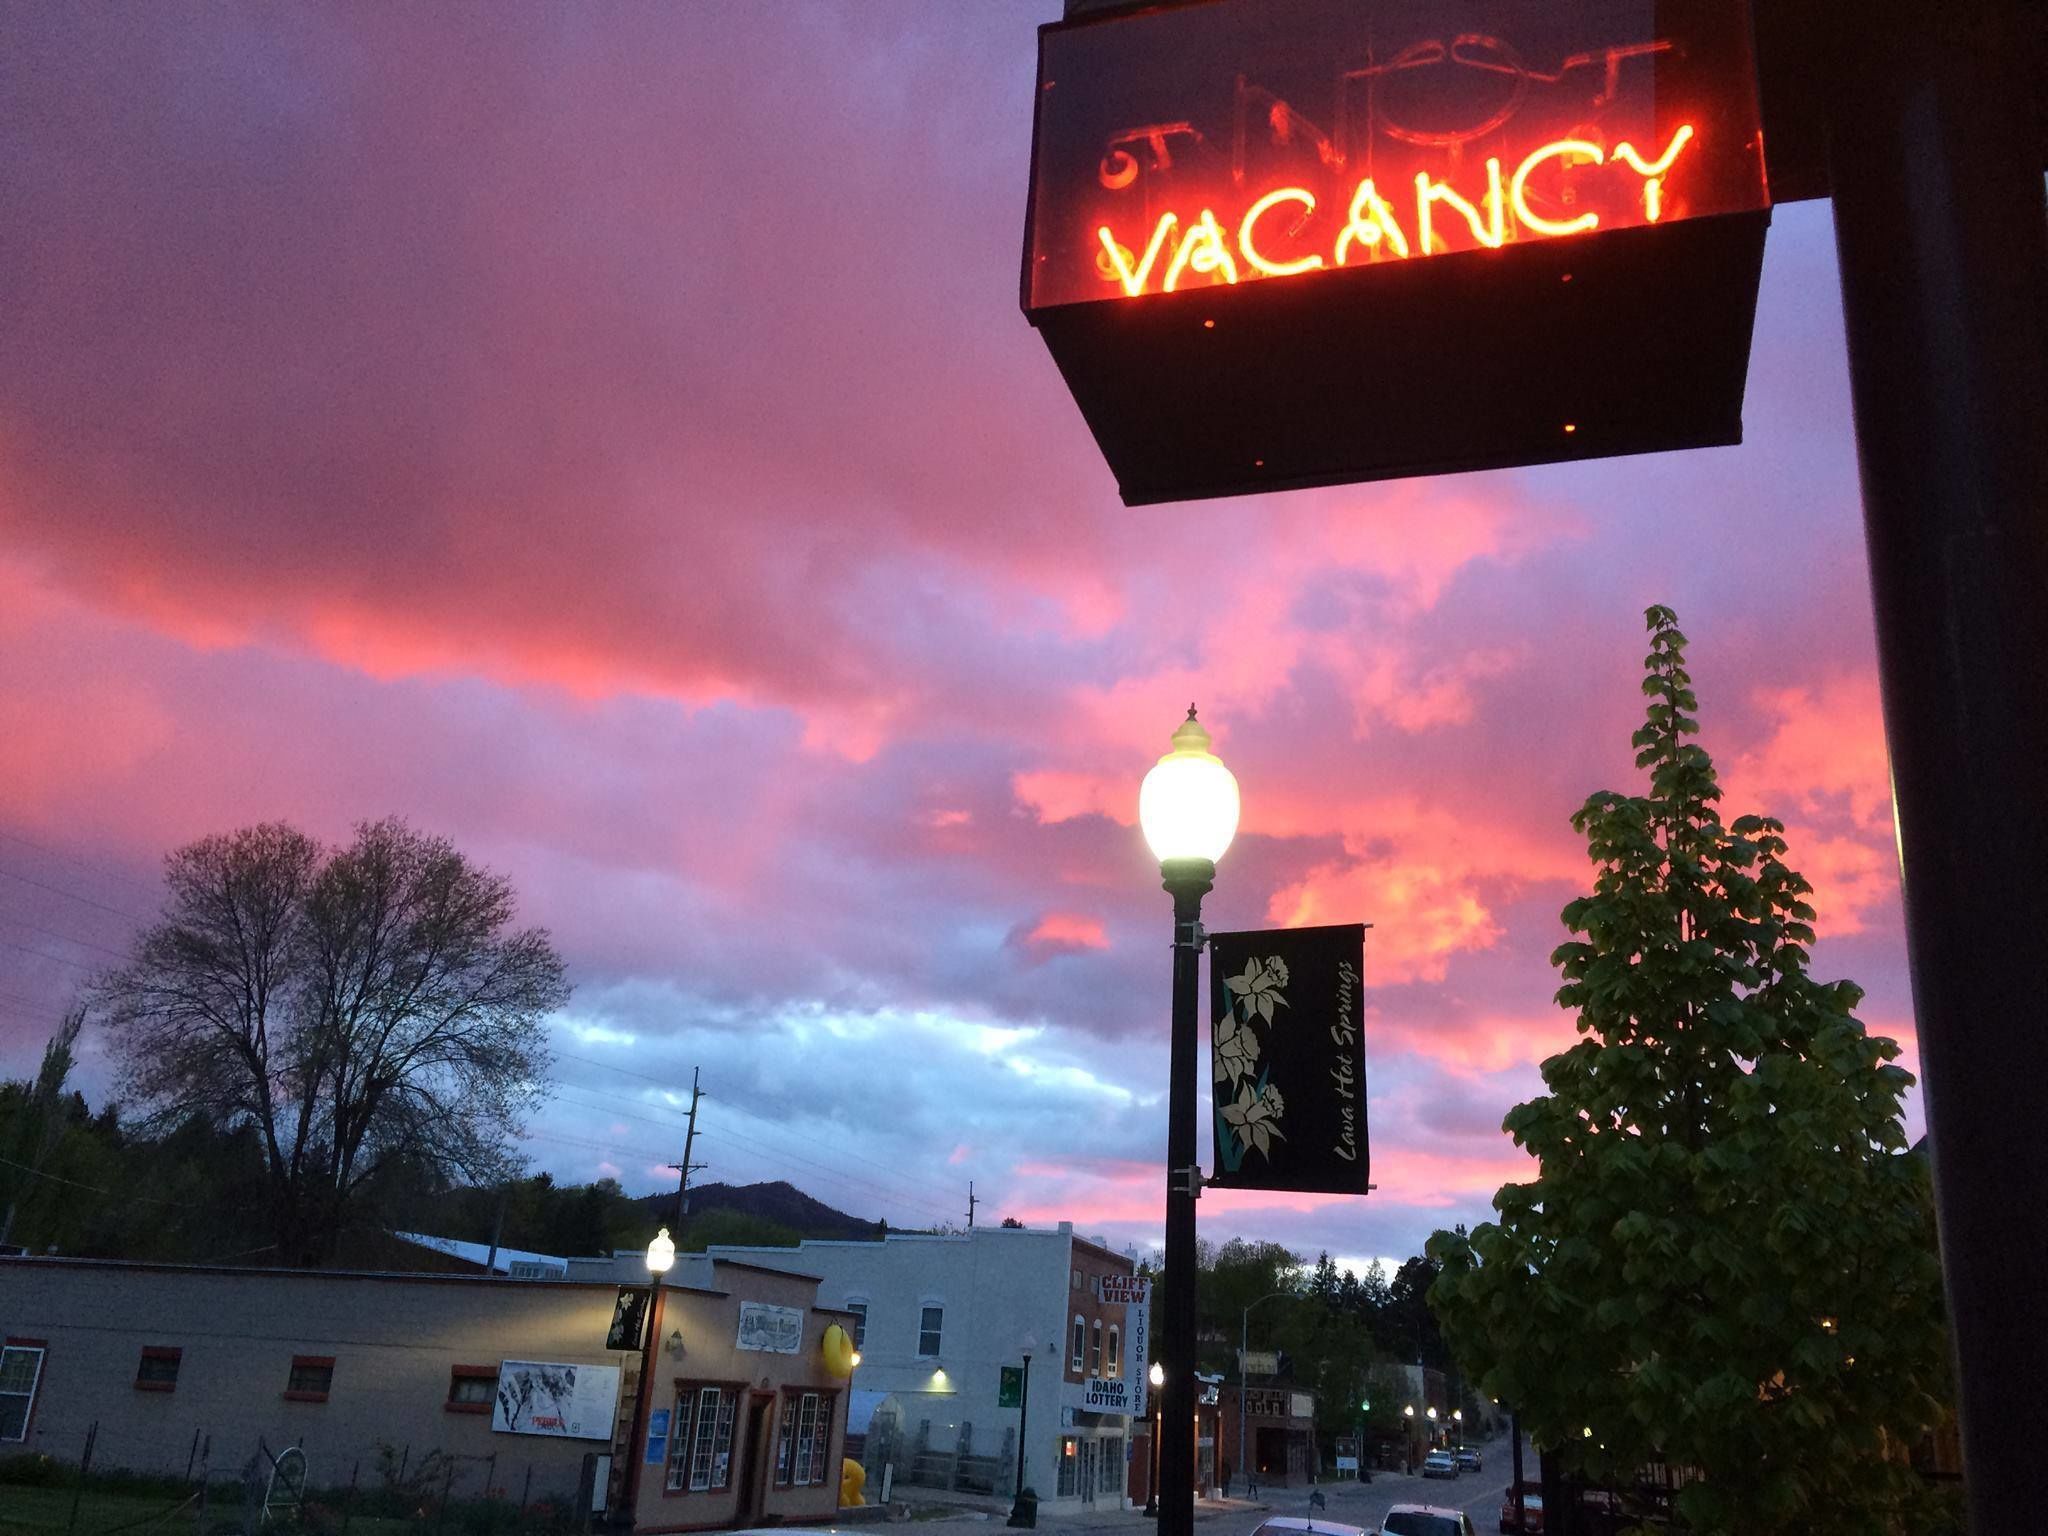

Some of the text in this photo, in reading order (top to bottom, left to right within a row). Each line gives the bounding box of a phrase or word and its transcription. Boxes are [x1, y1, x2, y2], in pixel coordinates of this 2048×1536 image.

[1098, 123, 1695, 297] VACANCY
[1330, 959, 1360, 1161] Lava Hot Springs
[1102, 1276, 1148, 1289] CLIFF
[1103, 1290, 1146, 1304] VIEW
[1136, 1309, 1144, 1362] LIQUOR
[1092, 1381, 1124, 1394] IDAHO
[1086, 1392, 1128, 1408] LOTTERY
